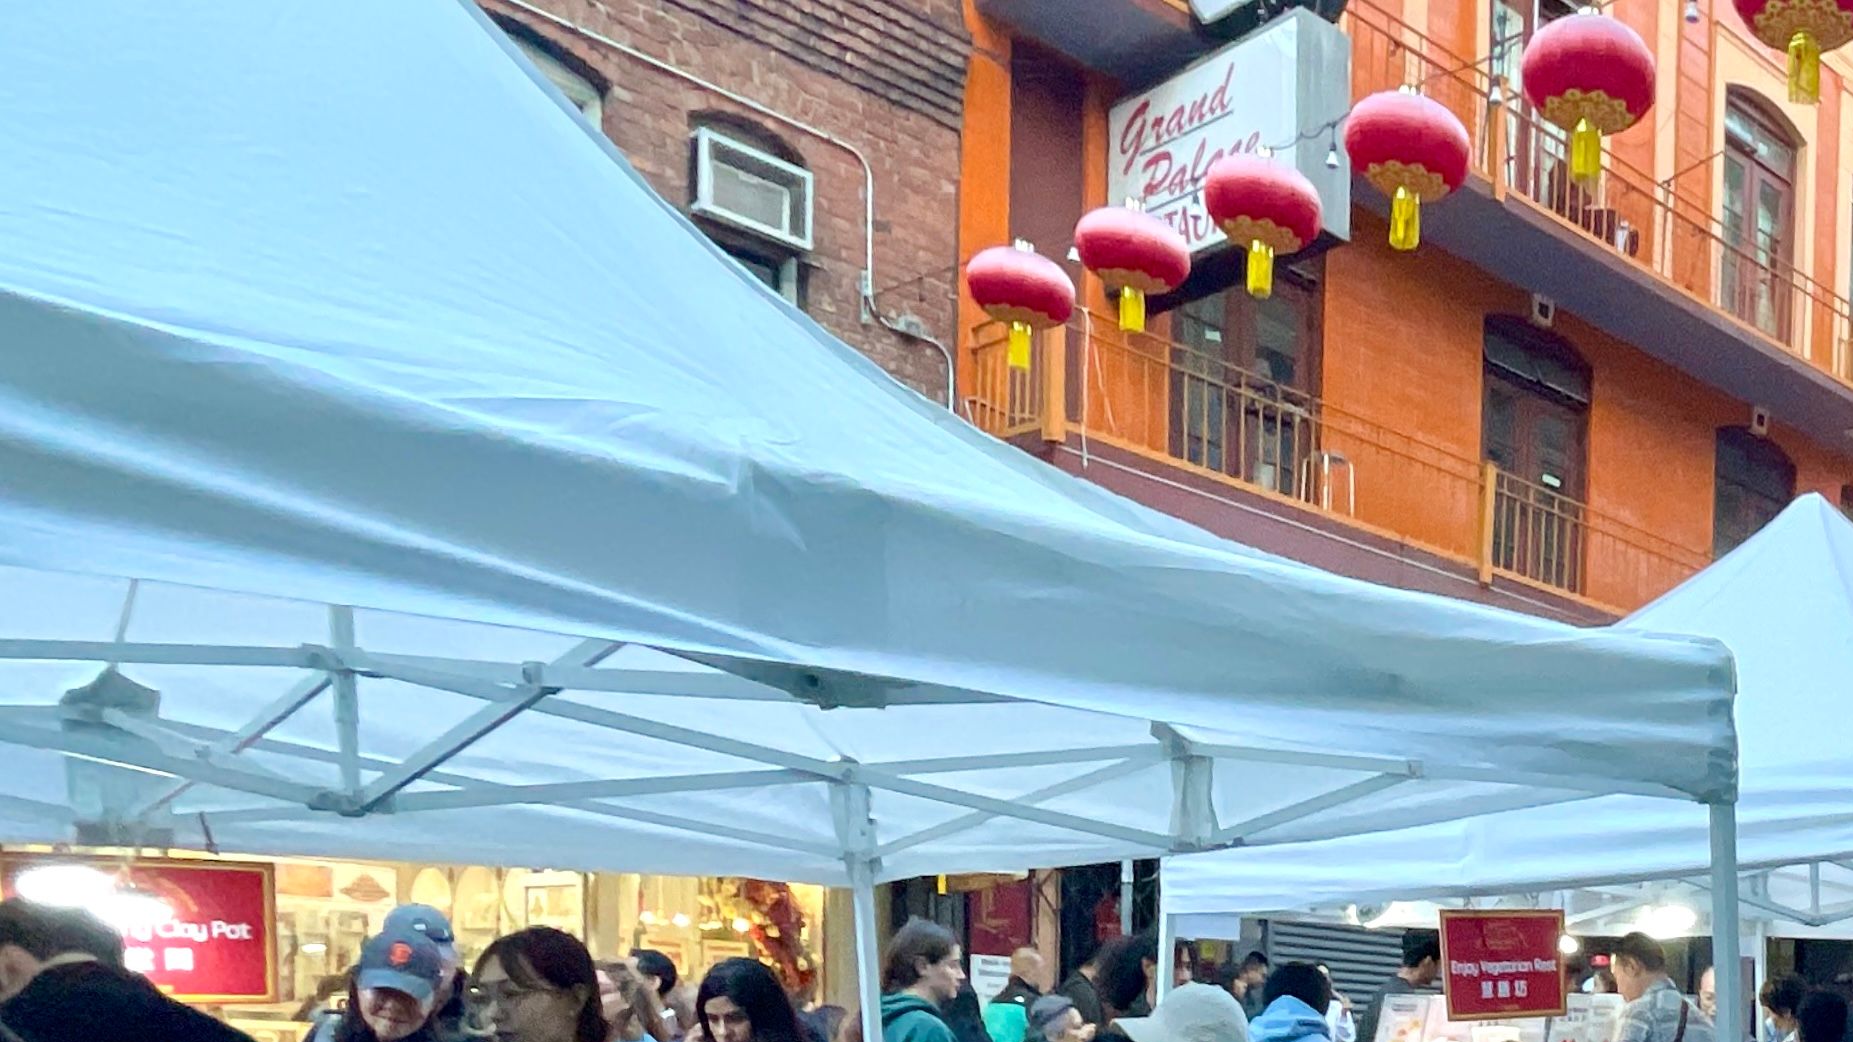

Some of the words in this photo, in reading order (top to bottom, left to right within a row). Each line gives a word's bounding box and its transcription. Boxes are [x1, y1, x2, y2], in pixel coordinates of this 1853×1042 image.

[1120, 62, 1235, 176] Grand
[155, 917, 209, 942] Clay
[211, 920, 253, 940] Pot
